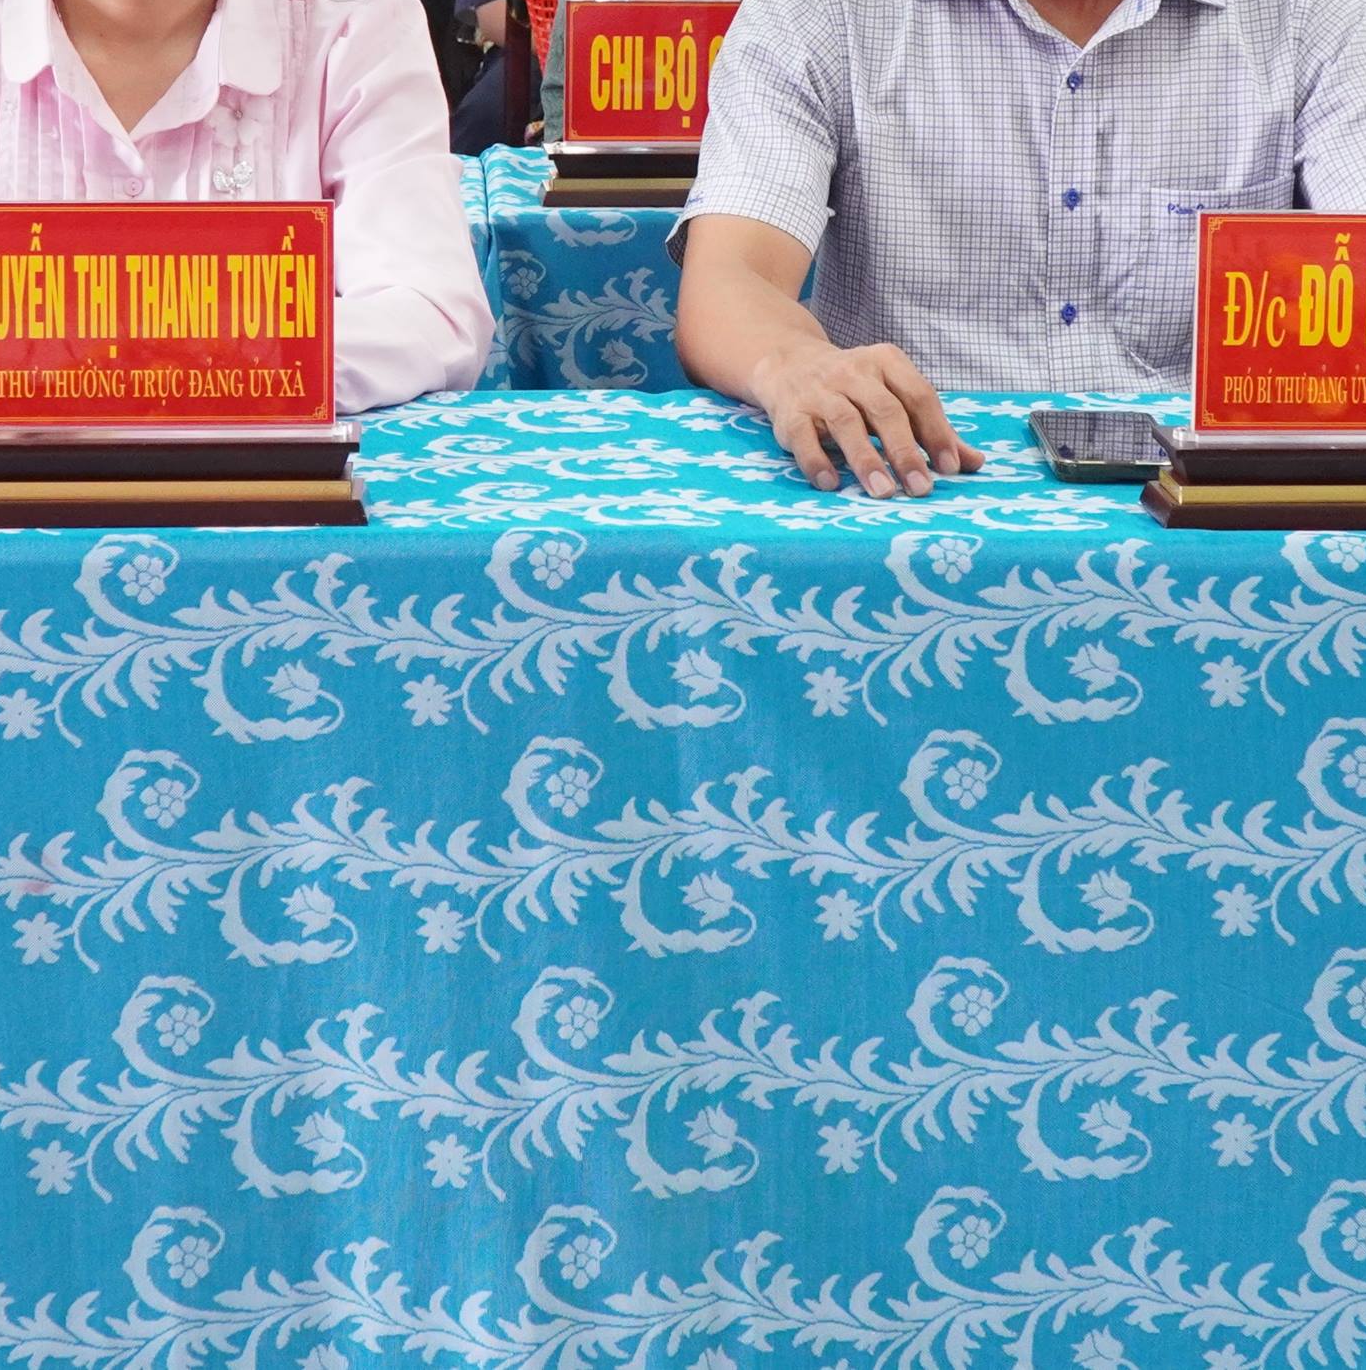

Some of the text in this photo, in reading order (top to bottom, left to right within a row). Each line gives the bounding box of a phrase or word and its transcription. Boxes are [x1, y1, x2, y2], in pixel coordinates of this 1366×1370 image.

[590, 19, 697, 128] CHI BỘ
[74, 254, 117, 359] THỊ
[126, 254, 219, 339] THANH
[227, 225, 316, 340] TUYỀN
[1222, 270, 1286, 348] Đ/c
[1299, 232, 1354, 348] ĐỖ
[41, 358, 126, 398] THƯỜNG
[131, 367, 184, 406] TRỰC
[188, 356, 244, 398] ĐẢNG
[249, 356, 278, 397] ỦY
[279, 360, 306, 397] XÃ
[1223, 367, 1253, 404] PHÓ
[1256, 367, 1273, 403] BÍ
[1275, 371, 1306, 403] THƯ
[1307, 364, 1347, 404] ĐẢNG
